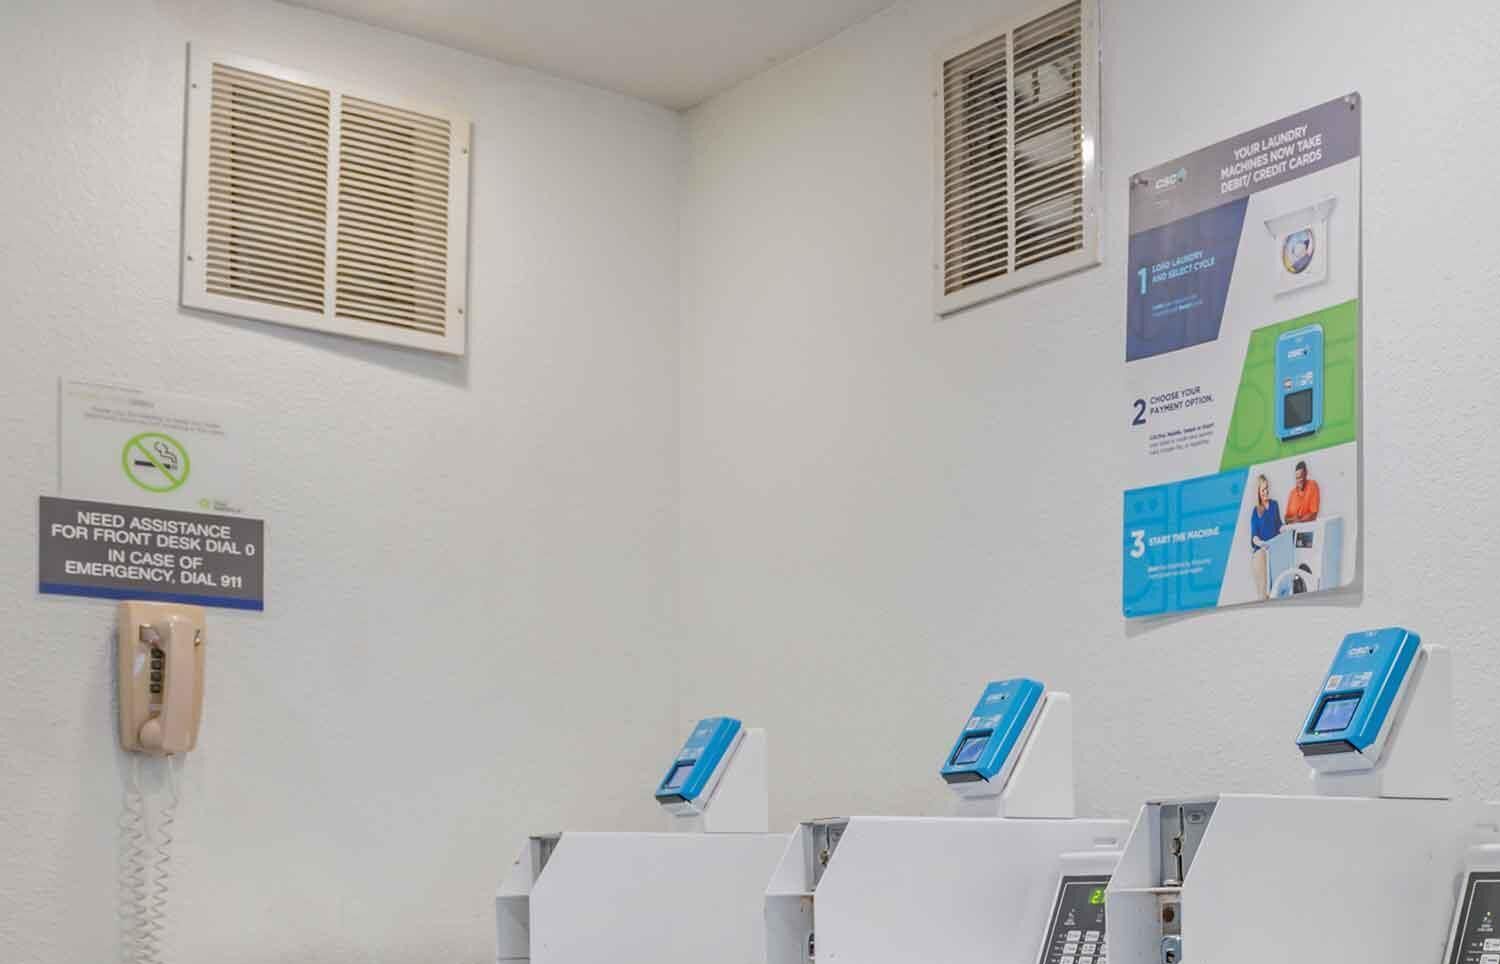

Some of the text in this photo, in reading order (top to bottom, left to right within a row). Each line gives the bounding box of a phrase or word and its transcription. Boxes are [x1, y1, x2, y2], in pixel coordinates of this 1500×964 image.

[1220, 133, 1322, 179] MACHINES NOW TAKE
[1233, 124, 1308, 160] YOUR LAUNDRY
[1252, 161, 1287, 183] CREDIT
[1289, 149, 1322, 170] CARDS
[1137, 266, 1147, 295] 1
[1150, 386, 1201, 405] CHOOSE YOUR
[1150, 401, 1183, 415] PAYMENT
[1131, 398, 1146, 426] 2
[77, 511, 231, 539] NEED ASSISTANCE
[51, 524, 88, 540] FOR
[93, 527, 151, 546] FRONT
[156, 533, 201, 552] DESK
[205, 538, 241, 555] DIAL
[1130, 529, 1145, 558] 3
[108, 548, 203, 570] IN CASE OF
[180, 571, 217, 586] DIAL
[220, 574, 242, 588] 911
